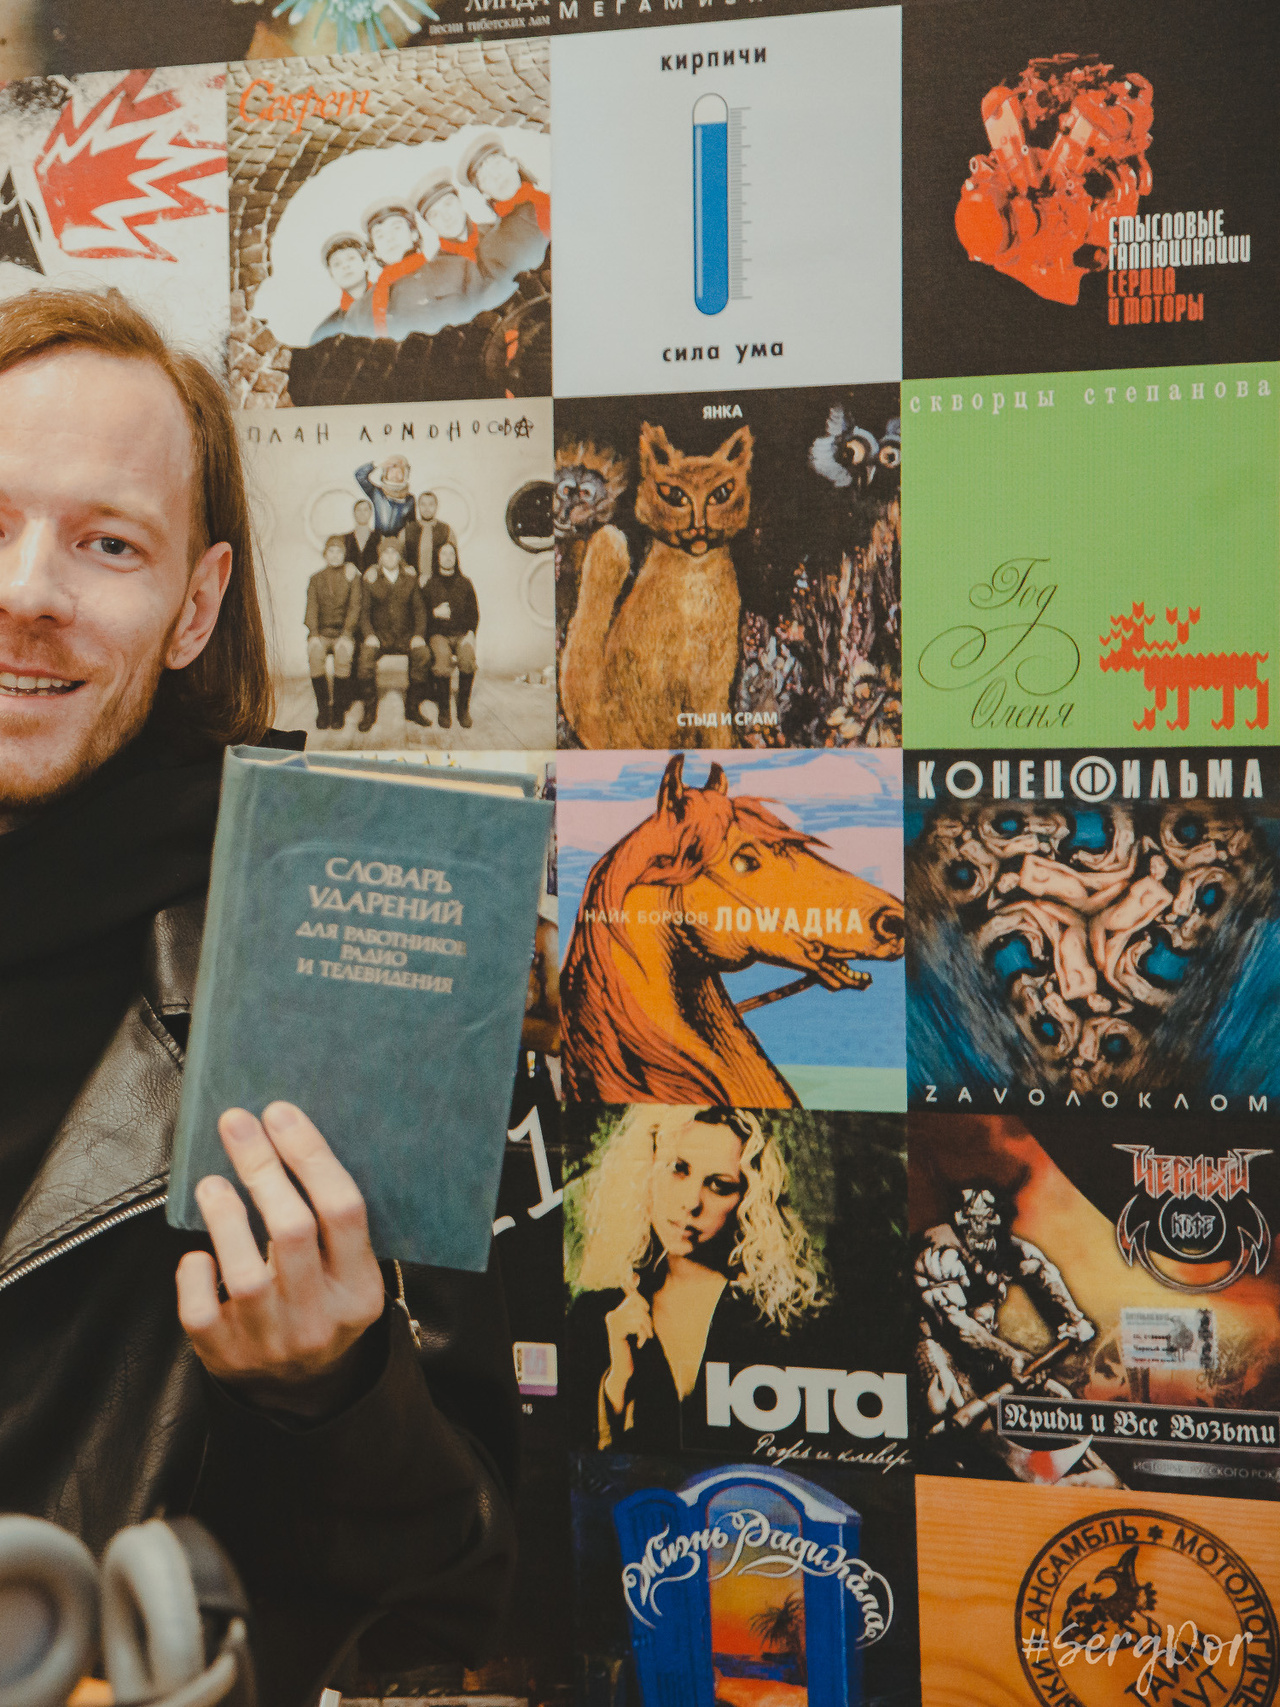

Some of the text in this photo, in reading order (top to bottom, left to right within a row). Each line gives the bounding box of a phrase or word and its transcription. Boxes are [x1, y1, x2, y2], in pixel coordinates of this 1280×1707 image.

[660, 46, 767, 75] кирпичи
[238, 78, 370, 135] Секрет
[1108, 208, 1225, 244] СМЫСЛОВЫЕ
[1108, 234, 1251, 271] ГАЛЛЮЦИНАЦИИ
[1107, 266, 1176, 298] СЕРДЦА
[1122, 292, 1205, 326] МОТОРЫ
[662, 341, 784, 364] сила ума
[702, 404, 744, 420] ЯНКА
[909, 378, 1272, 415] скворцы степанова
[247, 422, 330, 444] ПЛАН
[676, 711, 779, 729] СТЫД И СРАМ
[971, 675, 1075, 730] Оленя
[324, 857, 453, 895] СЛОВАРЬ
[308, 884, 466, 927] УДАРЕНИЙ
[584, 907, 632, 925] НАЙК
[637, 909, 709, 927] БОРЗОВ
[295, 920, 468, 957] ДЛЯ РАБОТНИКОВ
[339, 943, 409, 968] РАДИО
[295, 956, 455, 995] И ТЕЛЕВИДЕНИЯ
[1023, 1518, 1139, 1627] АНСАМБЛЬ
